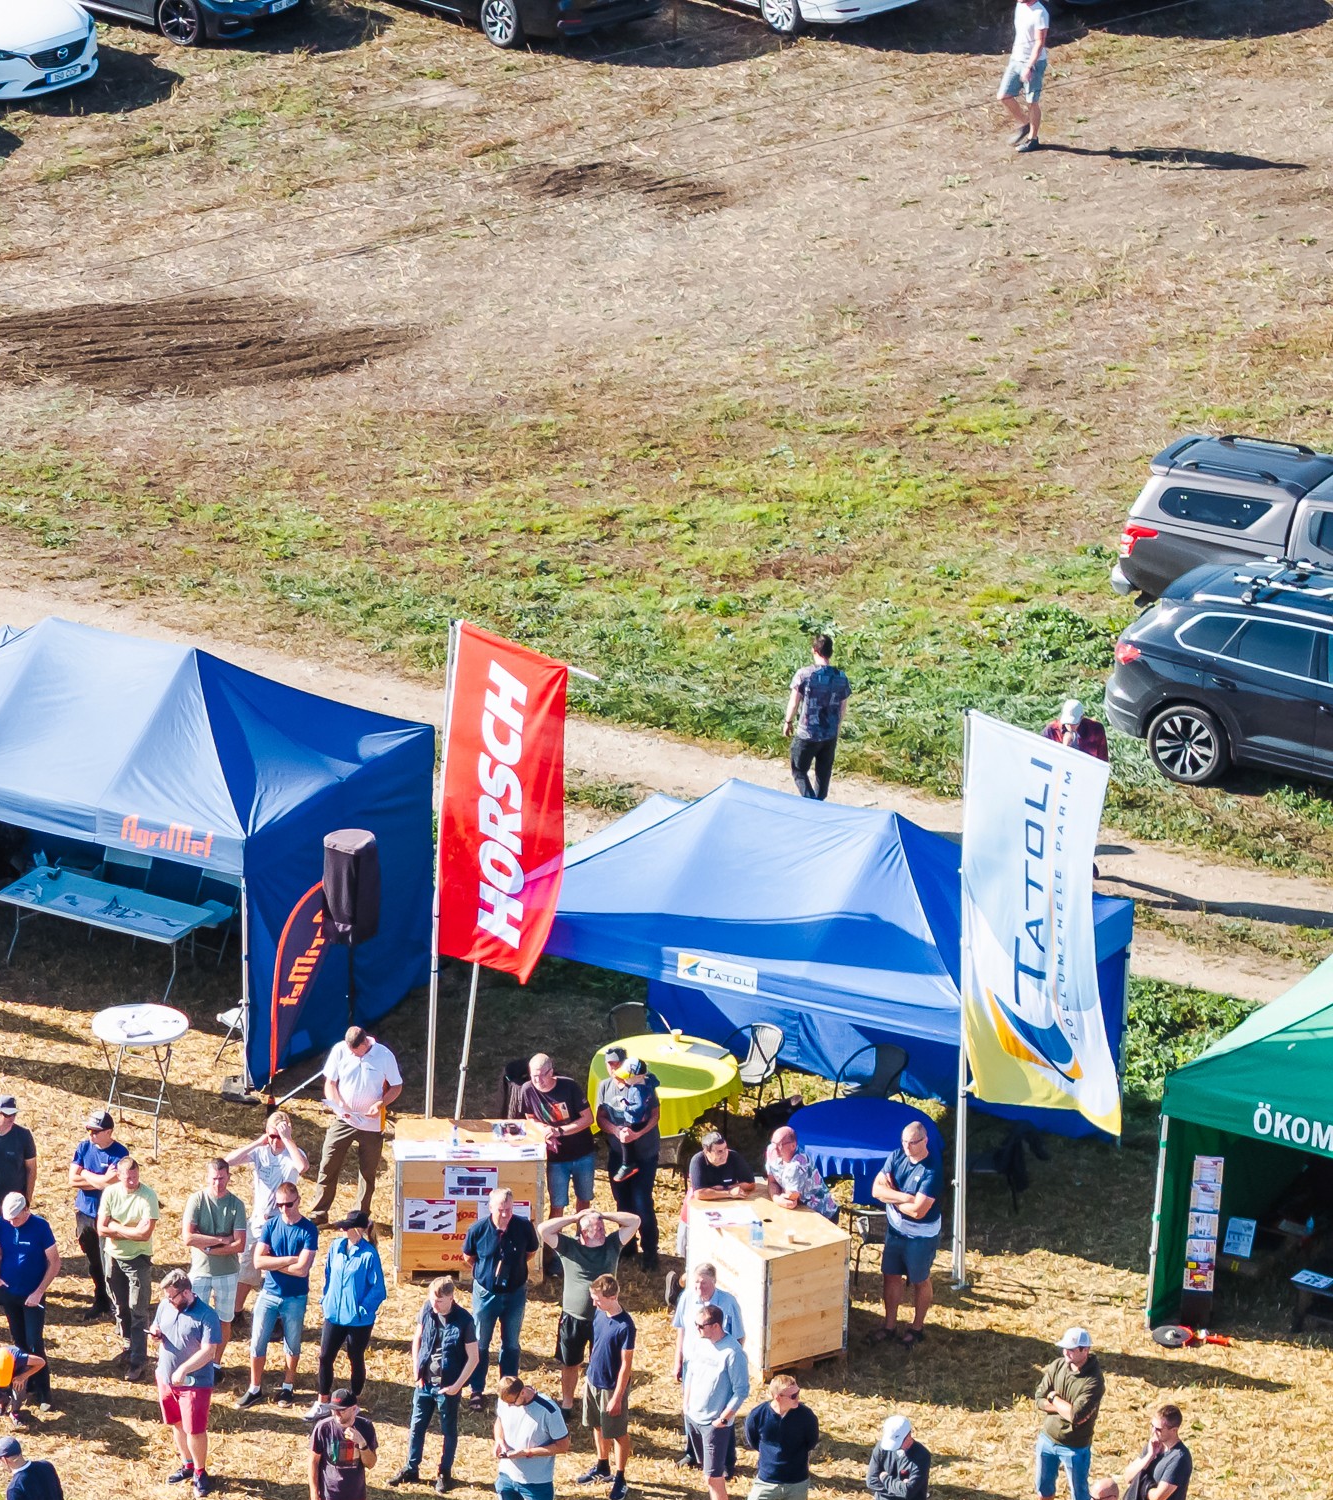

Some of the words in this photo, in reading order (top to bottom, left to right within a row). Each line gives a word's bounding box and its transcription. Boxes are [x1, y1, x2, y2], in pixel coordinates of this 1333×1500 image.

[120, 814, 214, 858] AgriMet
[477, 659, 528, 949] HORSCH
[1056, 770, 1073, 852] PARIM
[1014, 757, 1053, 1006] TATOLI
[700, 966, 755, 987] TATOLI
